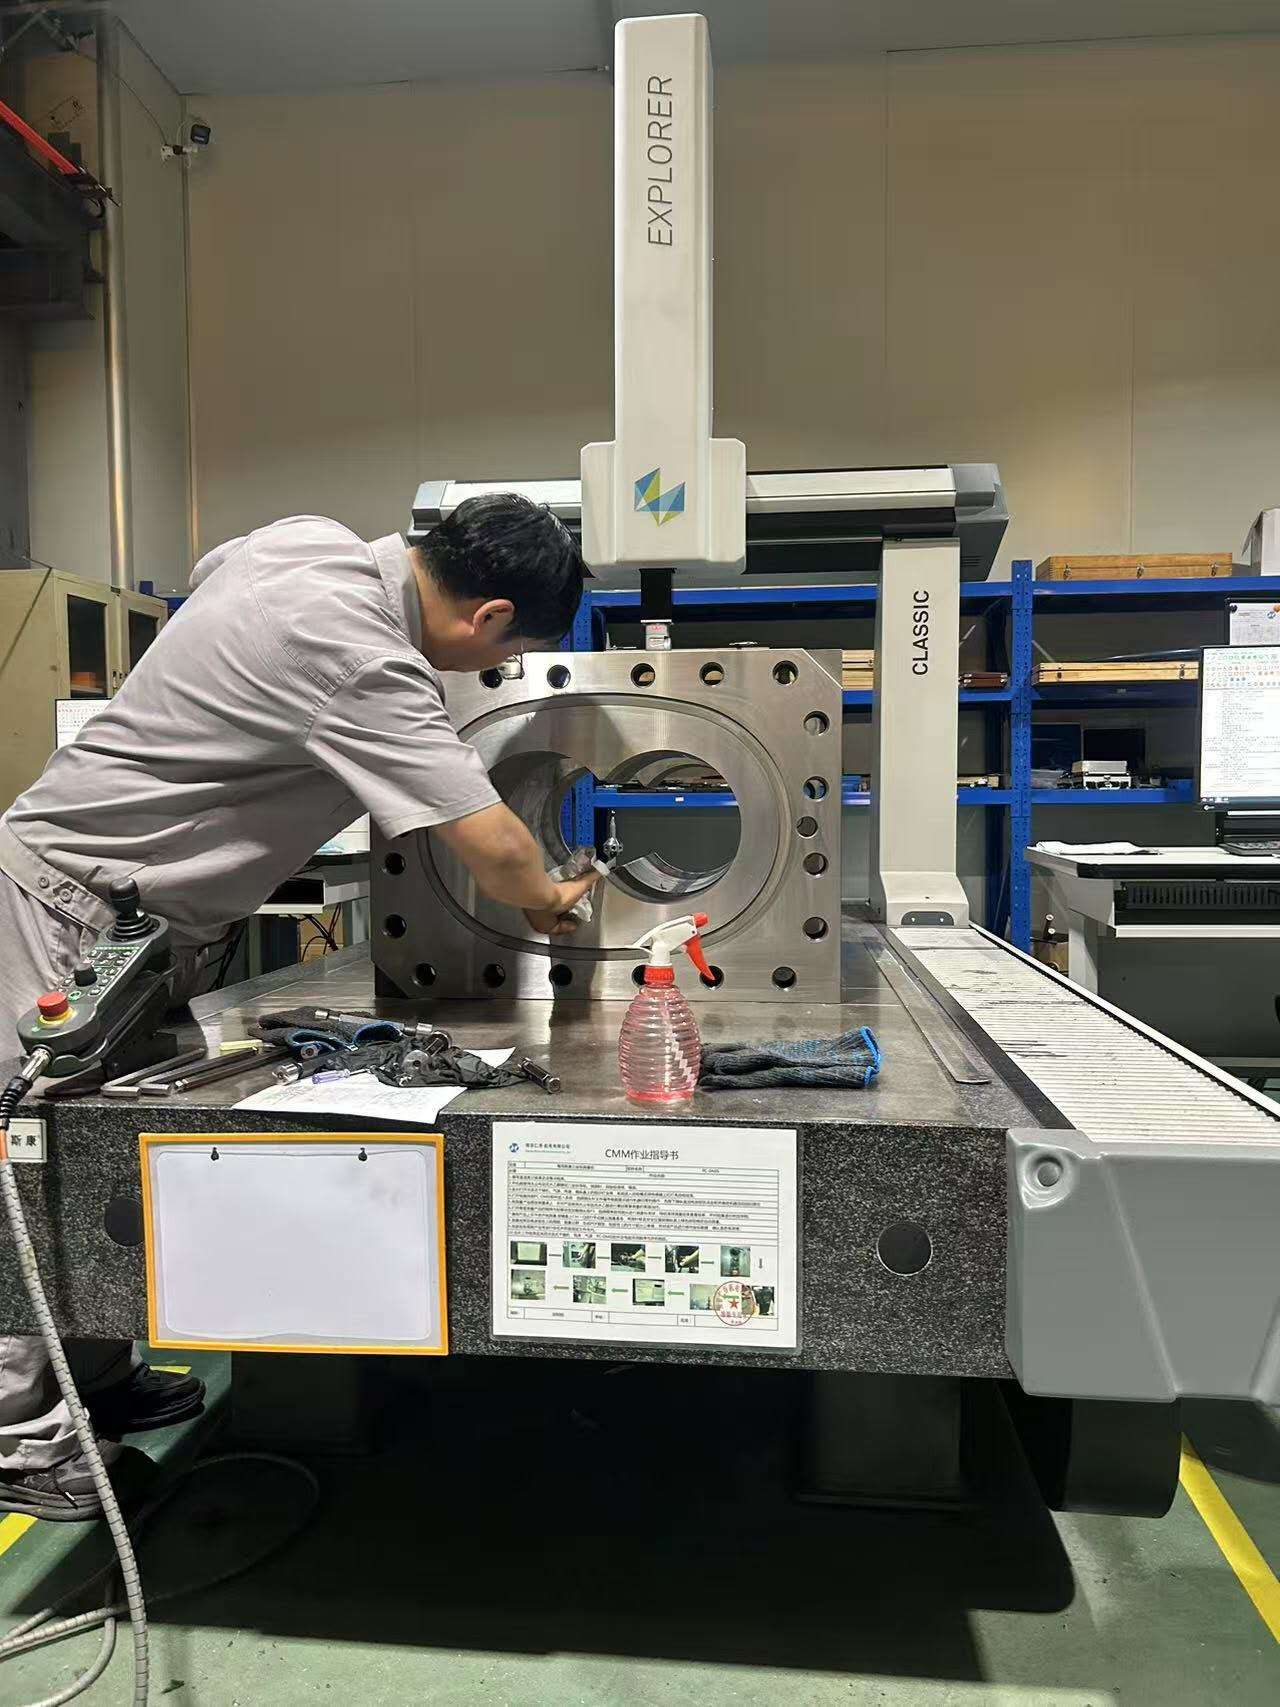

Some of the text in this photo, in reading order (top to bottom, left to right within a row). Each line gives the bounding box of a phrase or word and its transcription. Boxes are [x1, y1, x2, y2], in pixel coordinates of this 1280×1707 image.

[647, 75, 673, 246] EXPLORER
[912, 590, 930, 676] CLASSIC
[604, 1148, 679, 1160] CMM作业指导书
